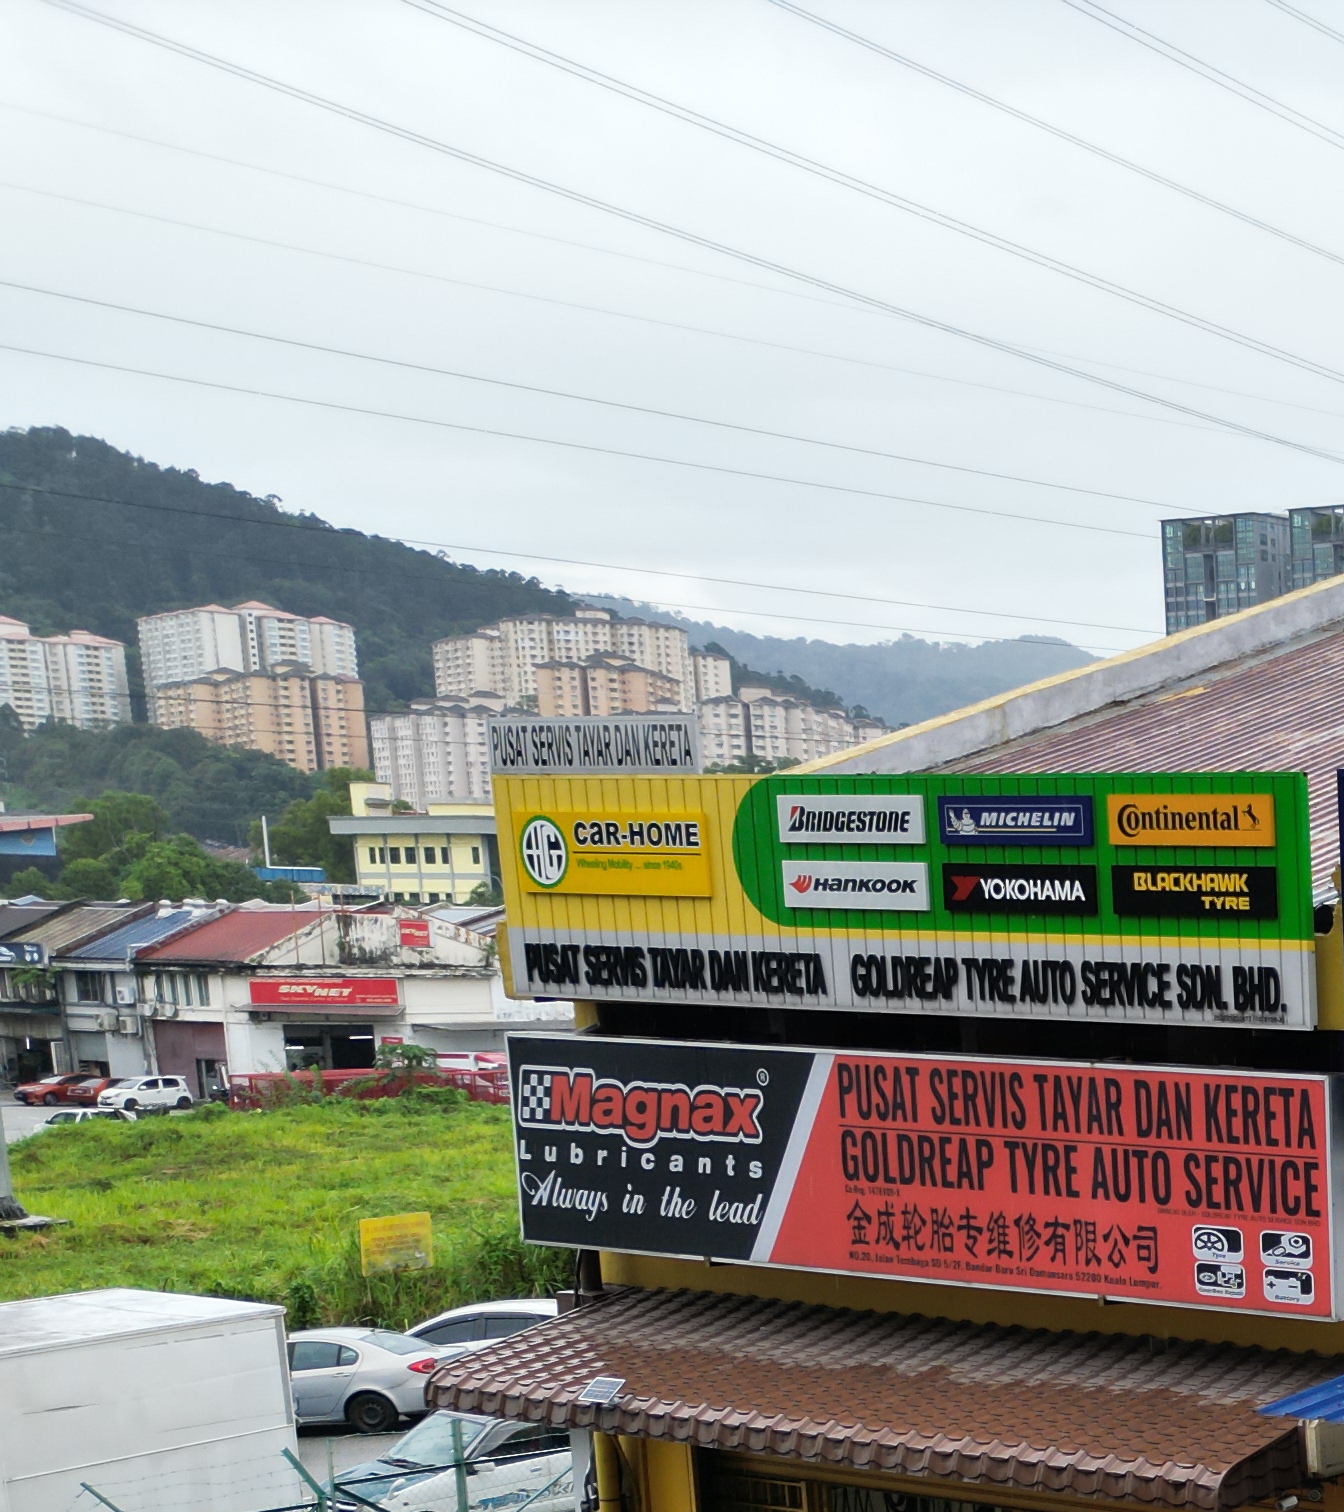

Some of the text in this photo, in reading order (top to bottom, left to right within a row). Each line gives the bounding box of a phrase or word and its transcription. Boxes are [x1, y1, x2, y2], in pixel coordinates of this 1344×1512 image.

[492, 723, 694, 767] PUSAT SERVIS TAYAR DAN KERETA
[787, 805, 911, 834] BRIDGESTONE
[980, 811, 1076, 828] MICHELIN
[1117, 804, 1240, 838] Continental
[980, 878, 1086, 902] YOKOHAMA
[1133, 872, 1249, 893] BLACKHAWK
[1201, 896, 1251, 911] TYRE
[278, 985, 353, 997] SKYNET
[524, 943, 1287, 1014] PUSAT SERVIS TAYAR DAN KERETA GOLDREAP TYRE AUTO SERVICE SDN. BHD.
[550, 1074, 763, 1141] Magnax
[837, 1062, 1317, 1150] PUSAT SERVIS TAYAR DAN KERETA
[519, 1139, 763, 1178] Lubricants
[841, 1129, 1321, 1218] GOLDREAP TYRE AUTO SERVICE
[521, 1170, 765, 1226] Always in the lead
[847, 1199, 1159, 1275] 金成轮胎专维修有限公司
[1015, 1266, 1027, 1276] Sri
[1104, 1273, 1126, 1285] Kuala
